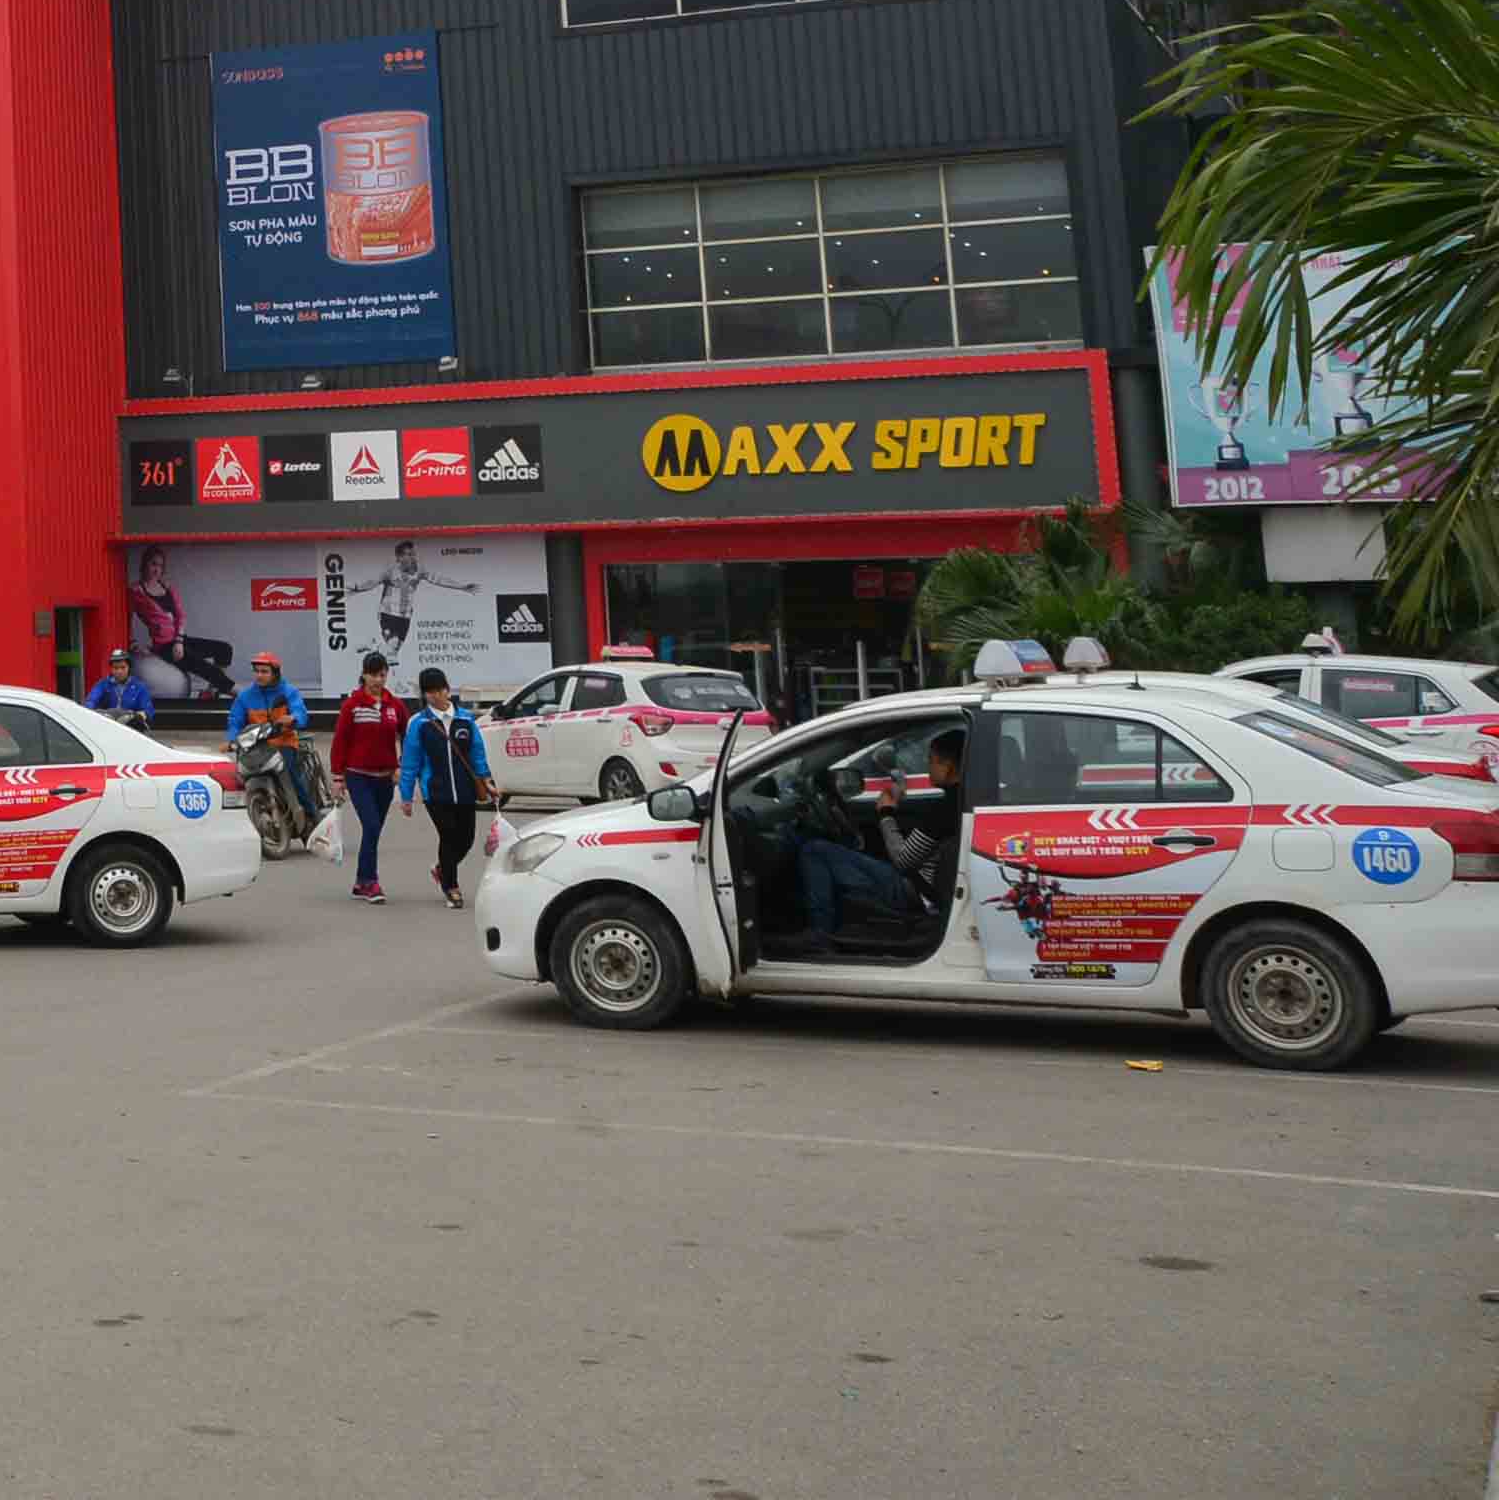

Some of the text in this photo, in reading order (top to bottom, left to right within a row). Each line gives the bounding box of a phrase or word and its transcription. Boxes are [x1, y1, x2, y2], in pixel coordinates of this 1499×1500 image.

[225, 143, 314, 186] BB
[226, 181, 315, 206] BLON
[228, 213, 317, 232] SƠN PHA MÀU
[244, 232, 302, 247] TỰ ĐỘNG
[365, 307, 397, 321] phong
[872, 412, 1046, 470] SPORT
[344, 473, 386, 486] Reebok
[405, 464, 468, 479] LI-NING
[478, 466, 540, 483] adidas
[1203, 476, 1265, 501] 2012
[324, 553, 348, 651] GENIUS
[499, 620, 545, 634] adidas
[1363, 845, 1412, 873] 1460
